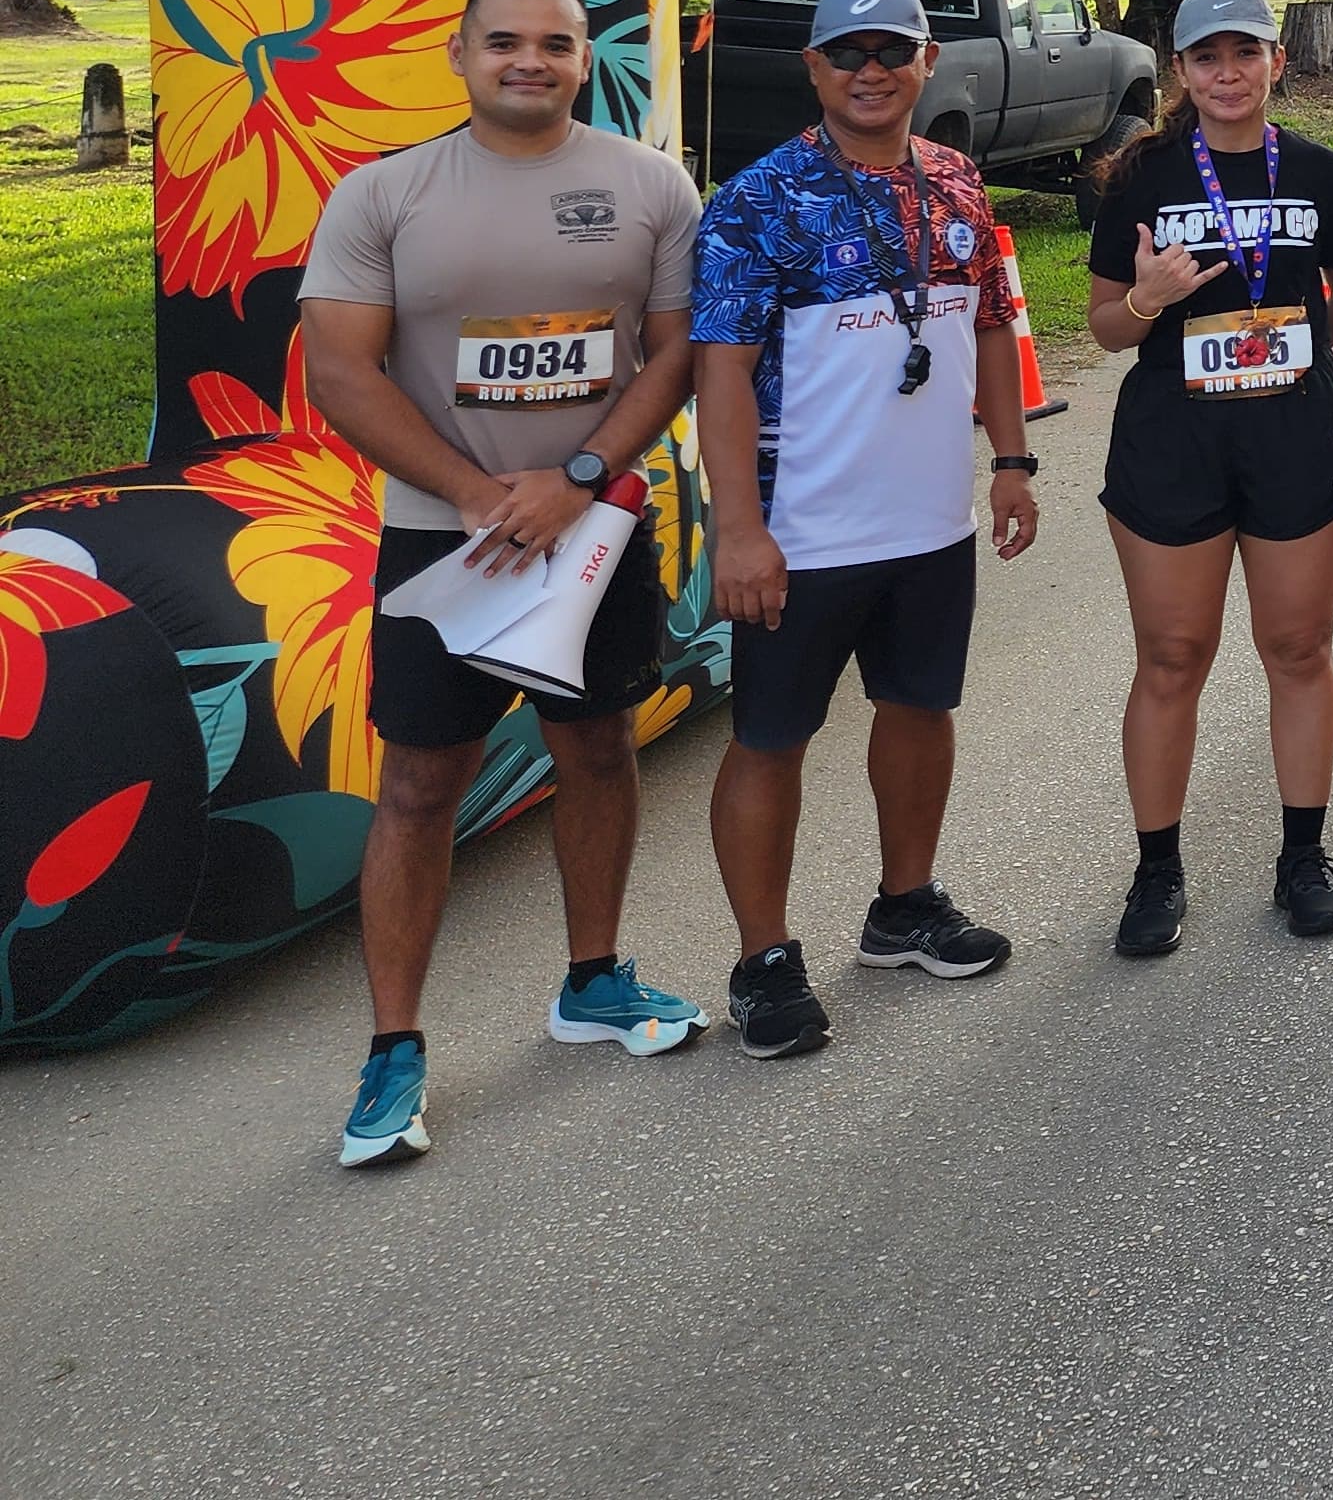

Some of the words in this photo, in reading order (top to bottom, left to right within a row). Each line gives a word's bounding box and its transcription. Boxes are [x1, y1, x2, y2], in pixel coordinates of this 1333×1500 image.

[1286, 208, 1319, 240] CO
[836, 310, 897, 332] RUN
[479, 339, 586, 380] 0934
[1201, 332, 1289, 372] 095
[478, 386, 516, 401] RUN
[524, 382, 590, 401] SAIPAN
[1204, 377, 1235, 393] RUN
[1241, 371, 1295, 390] SAIPAN
[580, 544, 609, 584] PYLE
